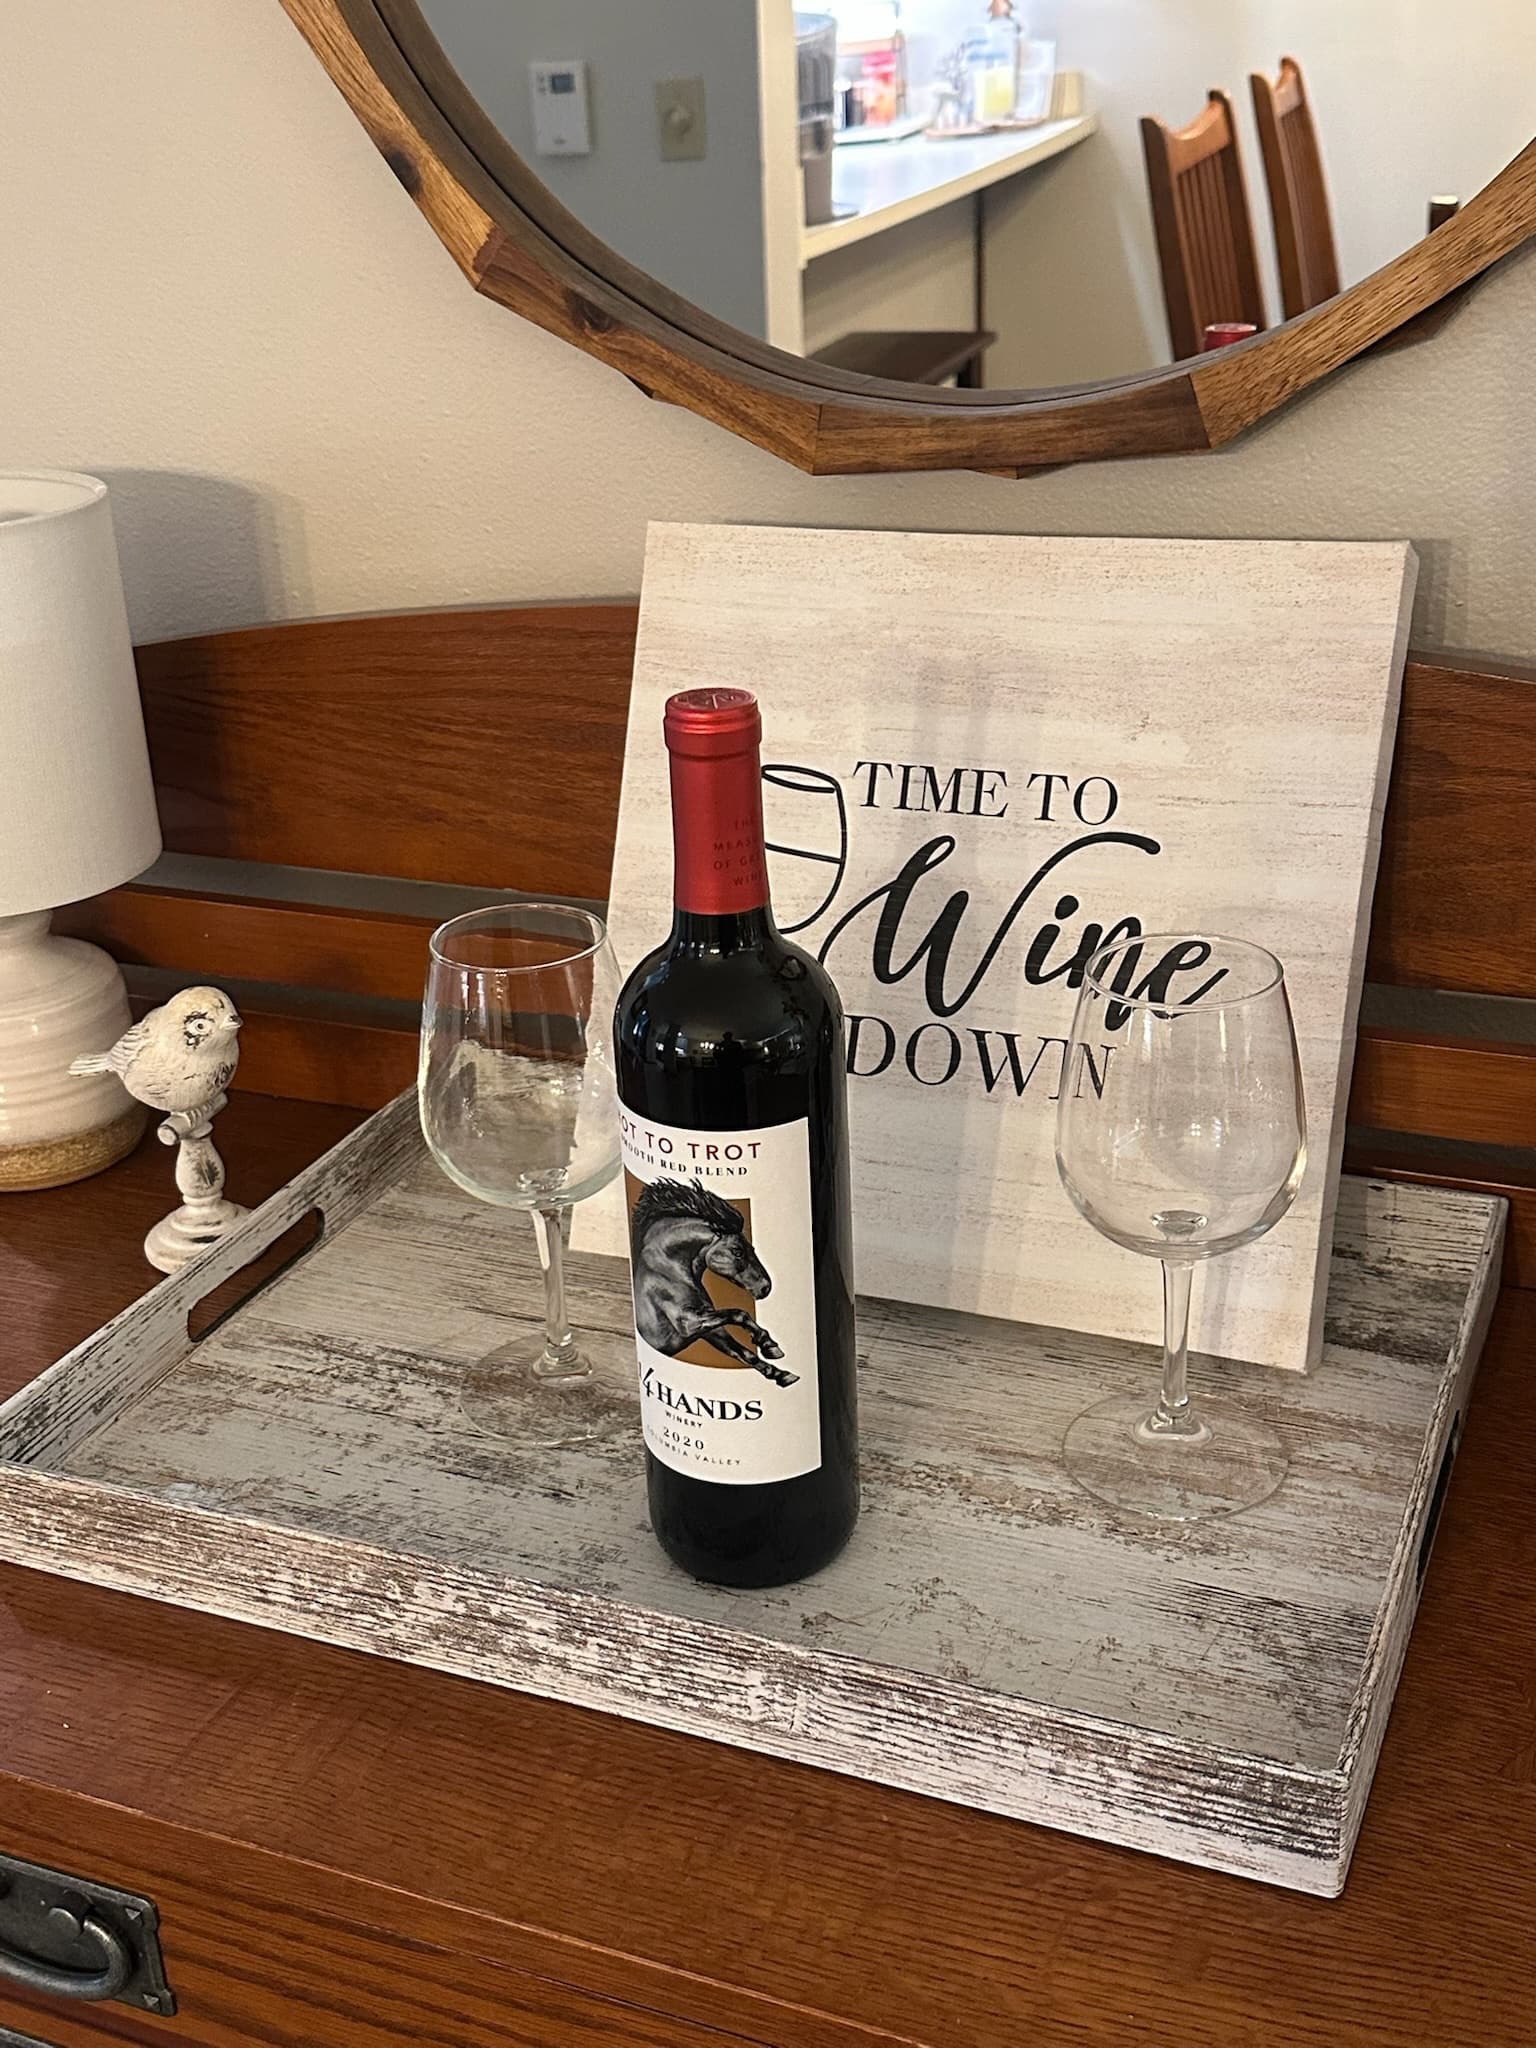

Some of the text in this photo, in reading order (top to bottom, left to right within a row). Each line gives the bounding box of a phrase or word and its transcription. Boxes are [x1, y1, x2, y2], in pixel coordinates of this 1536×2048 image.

[853, 761, 1118, 826] TIME TO
[818, 831, 1229, 1031] Wine
[844, 1014, 1117, 1101] DOWN
[644, 1130, 673, 1154] TO
[687, 1142, 762, 1161] TROT
[660, 1158, 687, 1173] RED
[695, 1165, 748, 1176] BLEND
[656, 1381, 763, 1421] HANDS
[665, 1410, 703, 1429] WINERY
[663, 1425, 705, 1451] 2020
[695, 1452, 741, 1466] VALLEY
